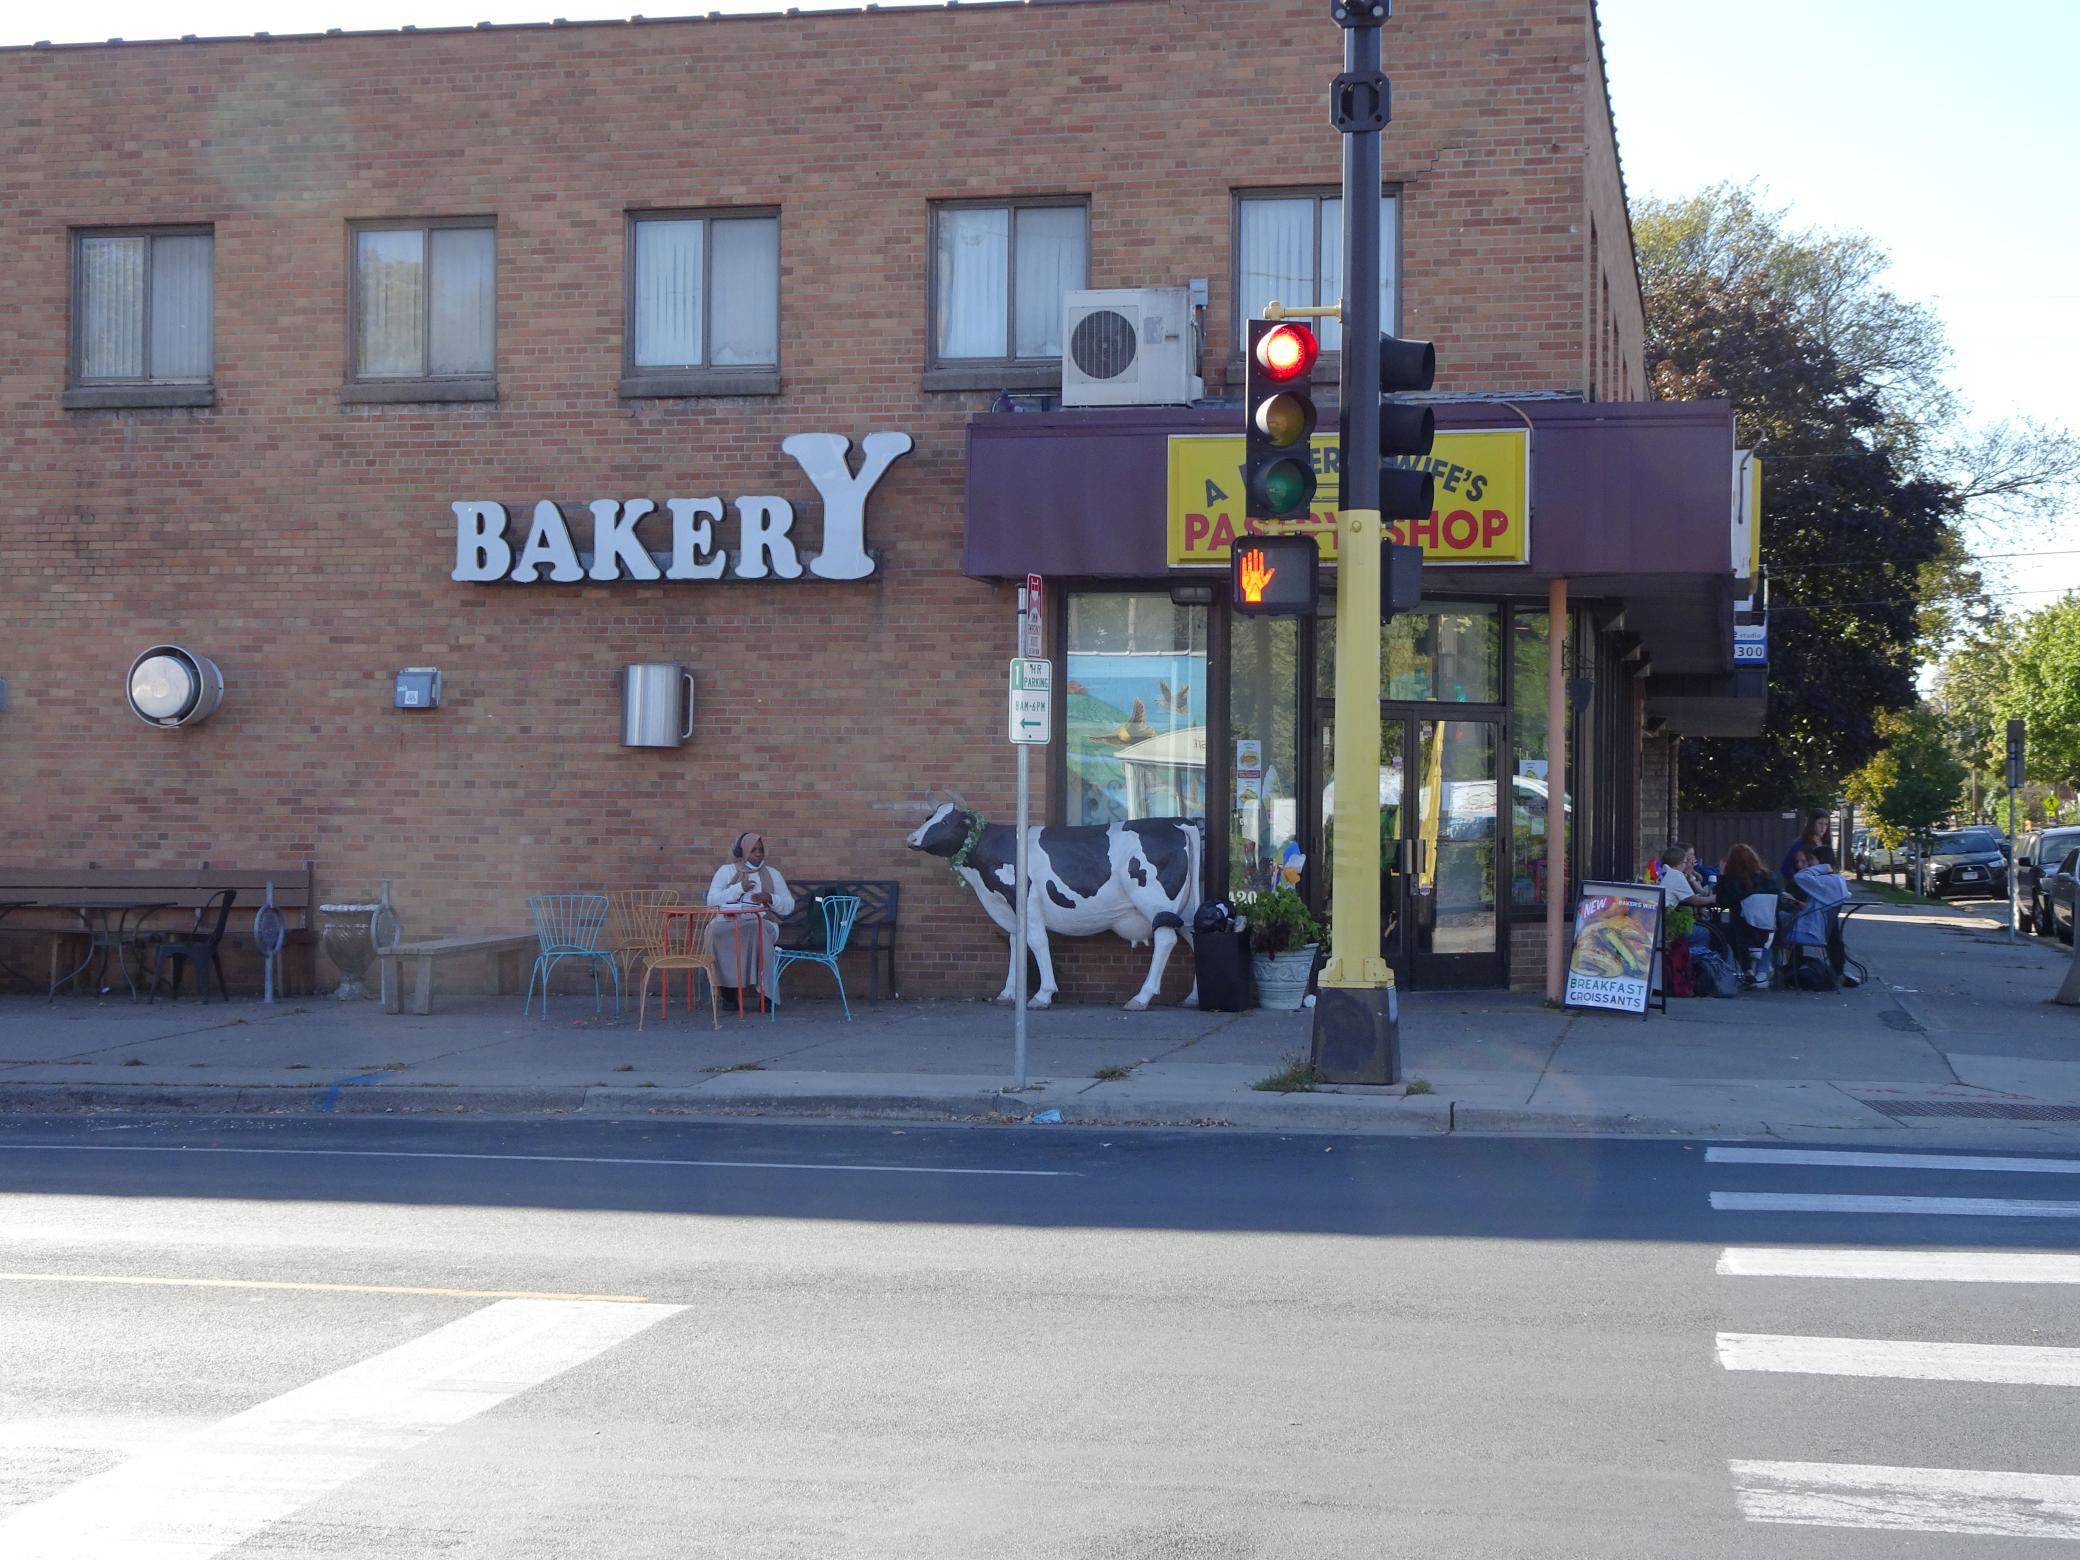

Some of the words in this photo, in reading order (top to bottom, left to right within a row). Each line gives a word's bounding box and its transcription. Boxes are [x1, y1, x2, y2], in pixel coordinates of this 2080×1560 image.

[1205, 478, 1229, 508] A
[451, 432, 913, 582] BAKERY
[1737, 646, 1763, 657] 300
[1024, 677, 1048, 688] PARKING
[1584, 896, 1607, 918] NEW
[1570, 978, 1644, 996] BREAKFAST
[1570, 991, 1641, 1008] CROISSANTS
